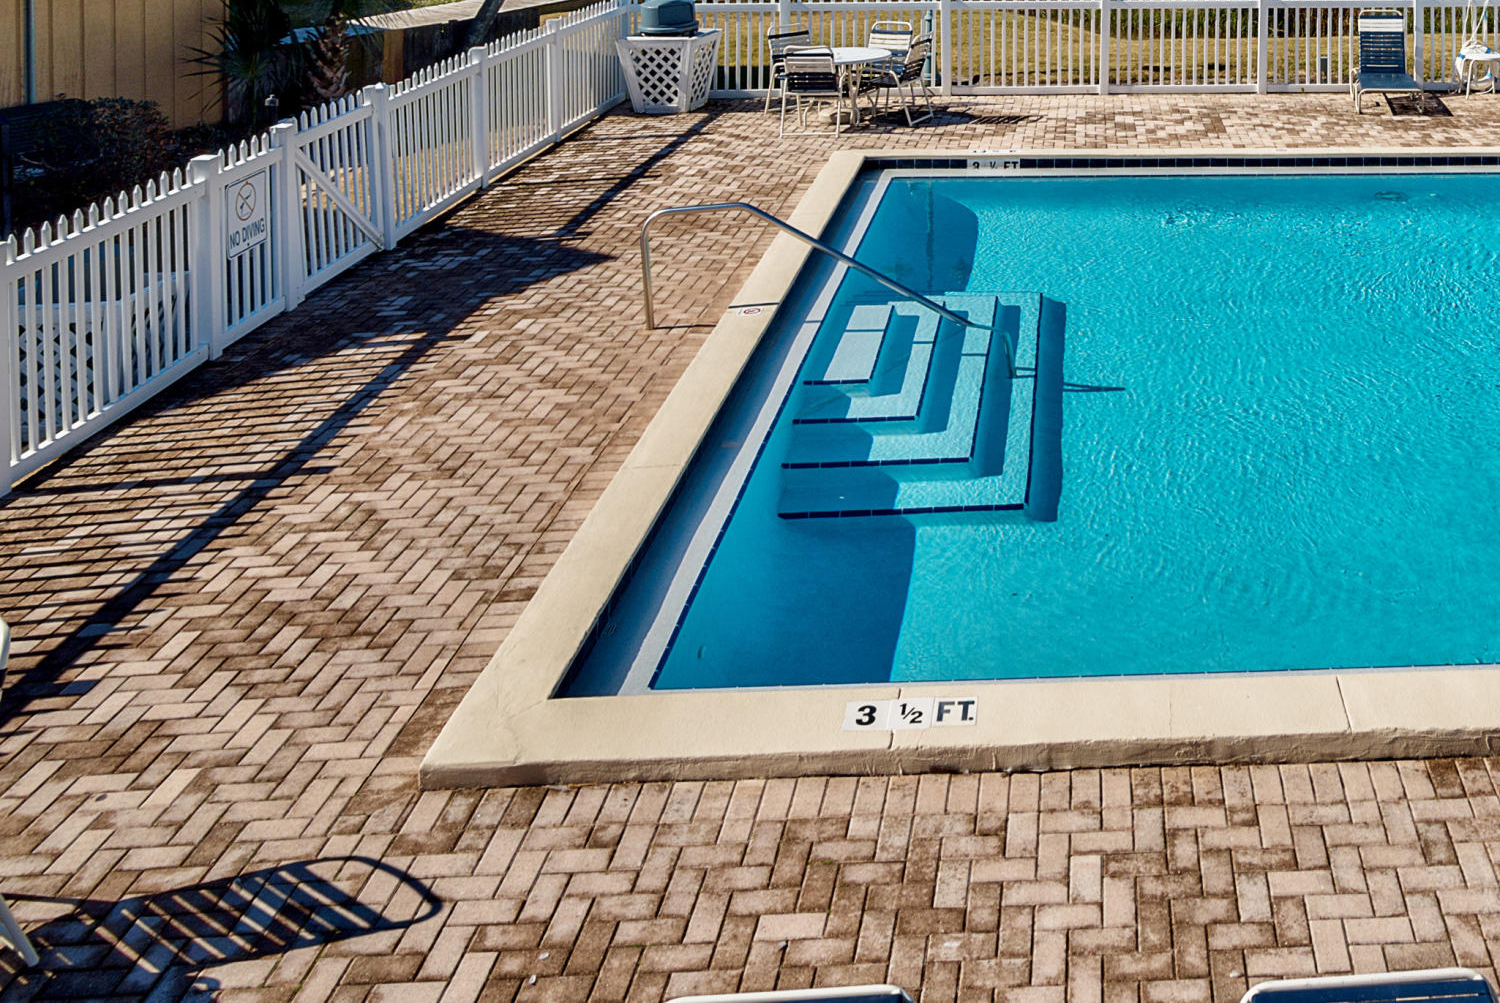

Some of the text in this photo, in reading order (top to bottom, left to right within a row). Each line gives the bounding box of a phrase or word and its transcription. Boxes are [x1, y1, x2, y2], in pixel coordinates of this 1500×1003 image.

[229, 218, 265, 249] NO DIVING
[855, 705, 877, 726] 3
[936, 700, 975, 722] FT.
